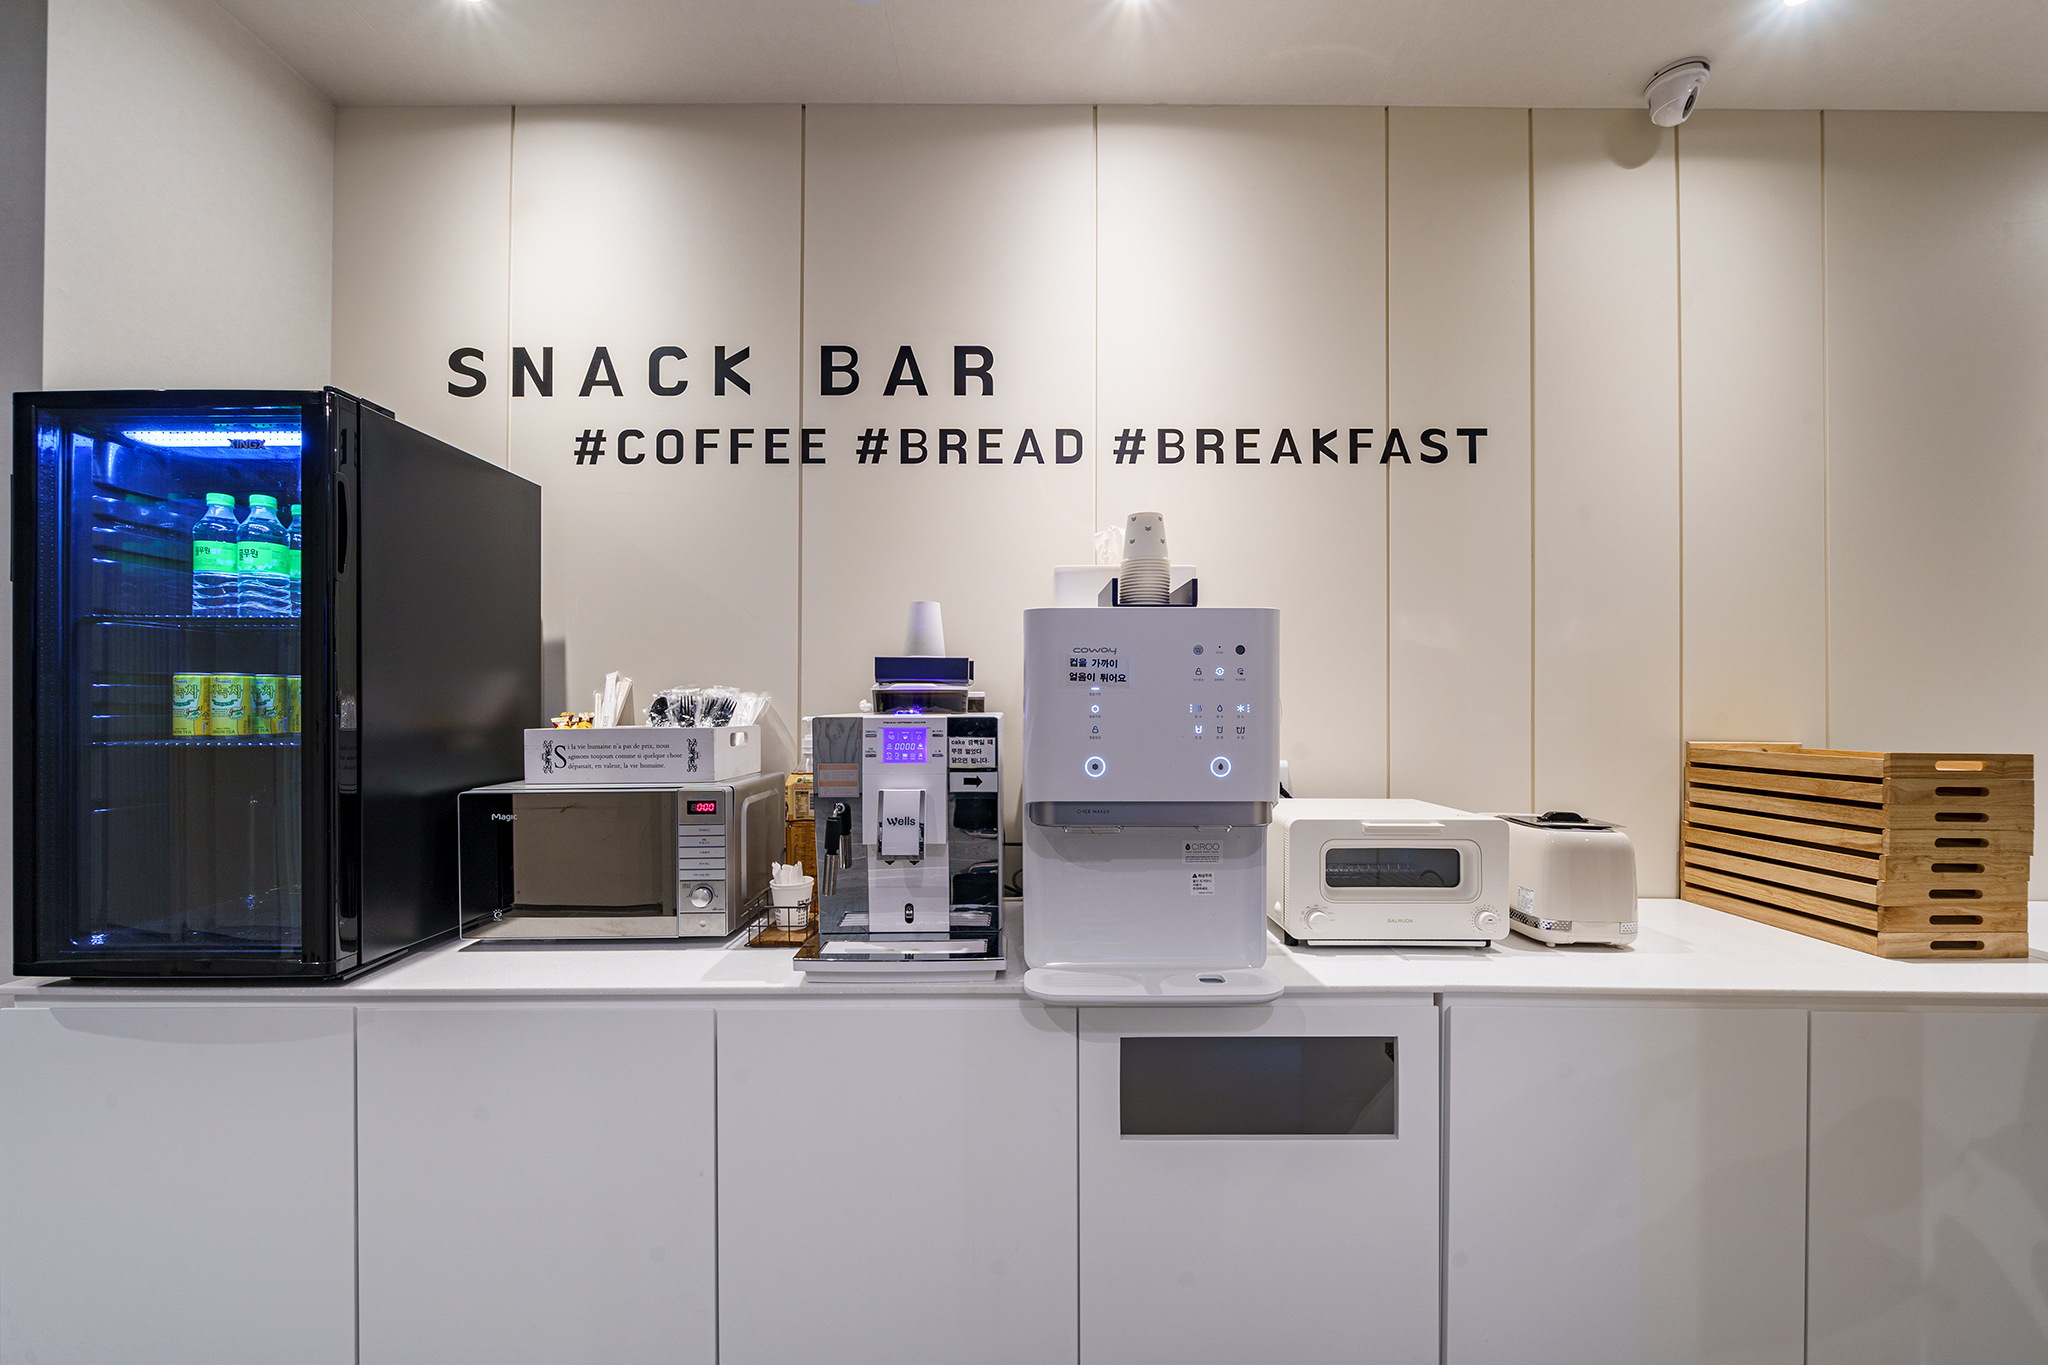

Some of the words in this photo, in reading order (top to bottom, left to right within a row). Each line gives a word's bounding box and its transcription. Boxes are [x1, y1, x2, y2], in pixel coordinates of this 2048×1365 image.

[447, 346, 751, 397] SNACK
[820, 345, 995, 396] BAR
[574, 428, 827, 465] #COFFEE
[856, 428, 1083, 465] #BREAD
[1113, 428, 1488, 465] #BREAKFAST
[239, 548, 258, 561] 풀무원
[1073, 647, 1117, 655] coway
[1070, 658, 1087, 668] 컵을
[1092, 659, 1118, 668] 가까이
[1069, 672, 1096, 682] 얼음이
[894, 743, 916, 751] 0000
[590, 753, 614, 761] toujours
[642, 752, 665, 760] quelque
[886, 816, 916, 826] Wells
[1191, 842, 1220, 851] CIROO
